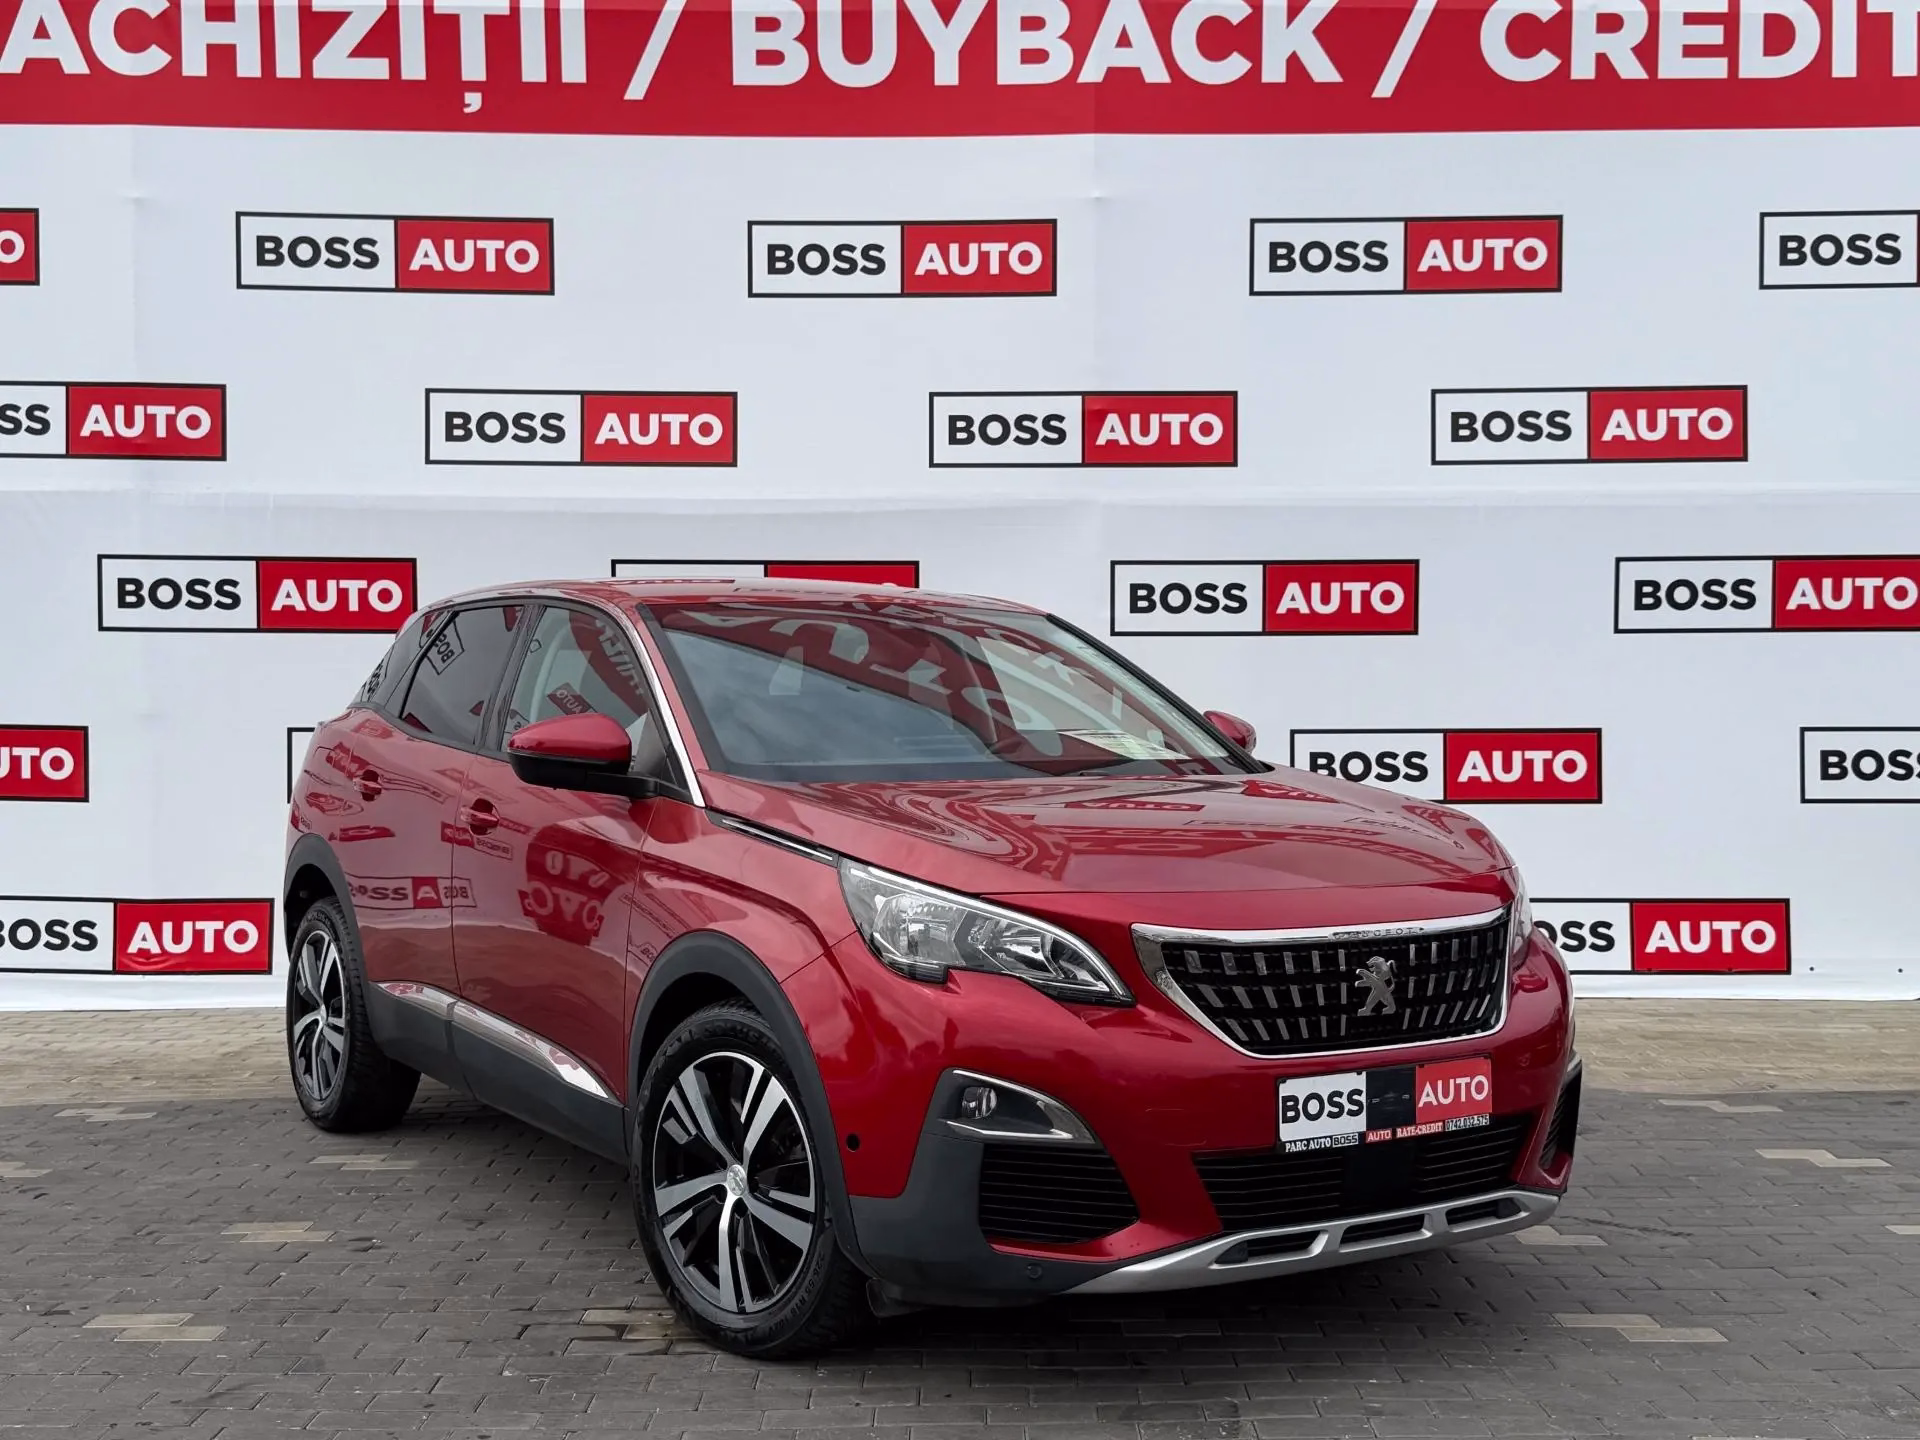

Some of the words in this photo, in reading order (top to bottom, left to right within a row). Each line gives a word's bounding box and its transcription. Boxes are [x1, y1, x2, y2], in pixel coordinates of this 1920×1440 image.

[0, 0, 587, 113] ACHIZIȚII
[731, 0, 1343, 86] BUYBACK
[257, 236, 379, 269] BOSS
[410, 239, 539, 272] AUTO
[768, 244, 885, 275] BOSS
[915, 242, 1042, 275] AUTO
[1269, 241, 1388, 272] BOSS
[1418, 238, 1547, 271] AUTO
[1779, 234, 1902, 267] BOSS
[80, 405, 211, 438] AUTO
[446, 412, 565, 443] BOSS
[595, 413, 722, 445] AUTO
[949, 414, 1066, 445] BOSS
[1096, 413, 1223, 445] AUTO
[1451, 411, 1571, 442] BOSS
[1602, 408, 1732, 440] AUTO
[118, 578, 241, 610] BOSS
[272, 580, 402, 612] AUTO
[1130, 583, 1247, 614] BOSS
[1277, 582, 1404, 613] AUTO
[1635, 579, 1756, 610] BOSS
[1787, 577, 1918, 609] AUTO
[1310, 751, 1428, 782] BOSS
[1458, 750, 1587, 782] AUTO
[1820, 750, 1920, 781] BOS
[0, 919, 97, 951] OSS
[128, 921, 258, 953] AUTO
[1646, 921, 1775, 953] AUTO
[1281, 1088, 1364, 1124] BOSS
[1418, 1075, 1489, 1107] AUTO
[1285, 1140, 1307, 1153] PARC
[1308, 1137, 1331, 1150] AUTO
[1333, 1133, 1357, 1146] BOSS
[1367, 1130, 1391, 1142] AUTO
